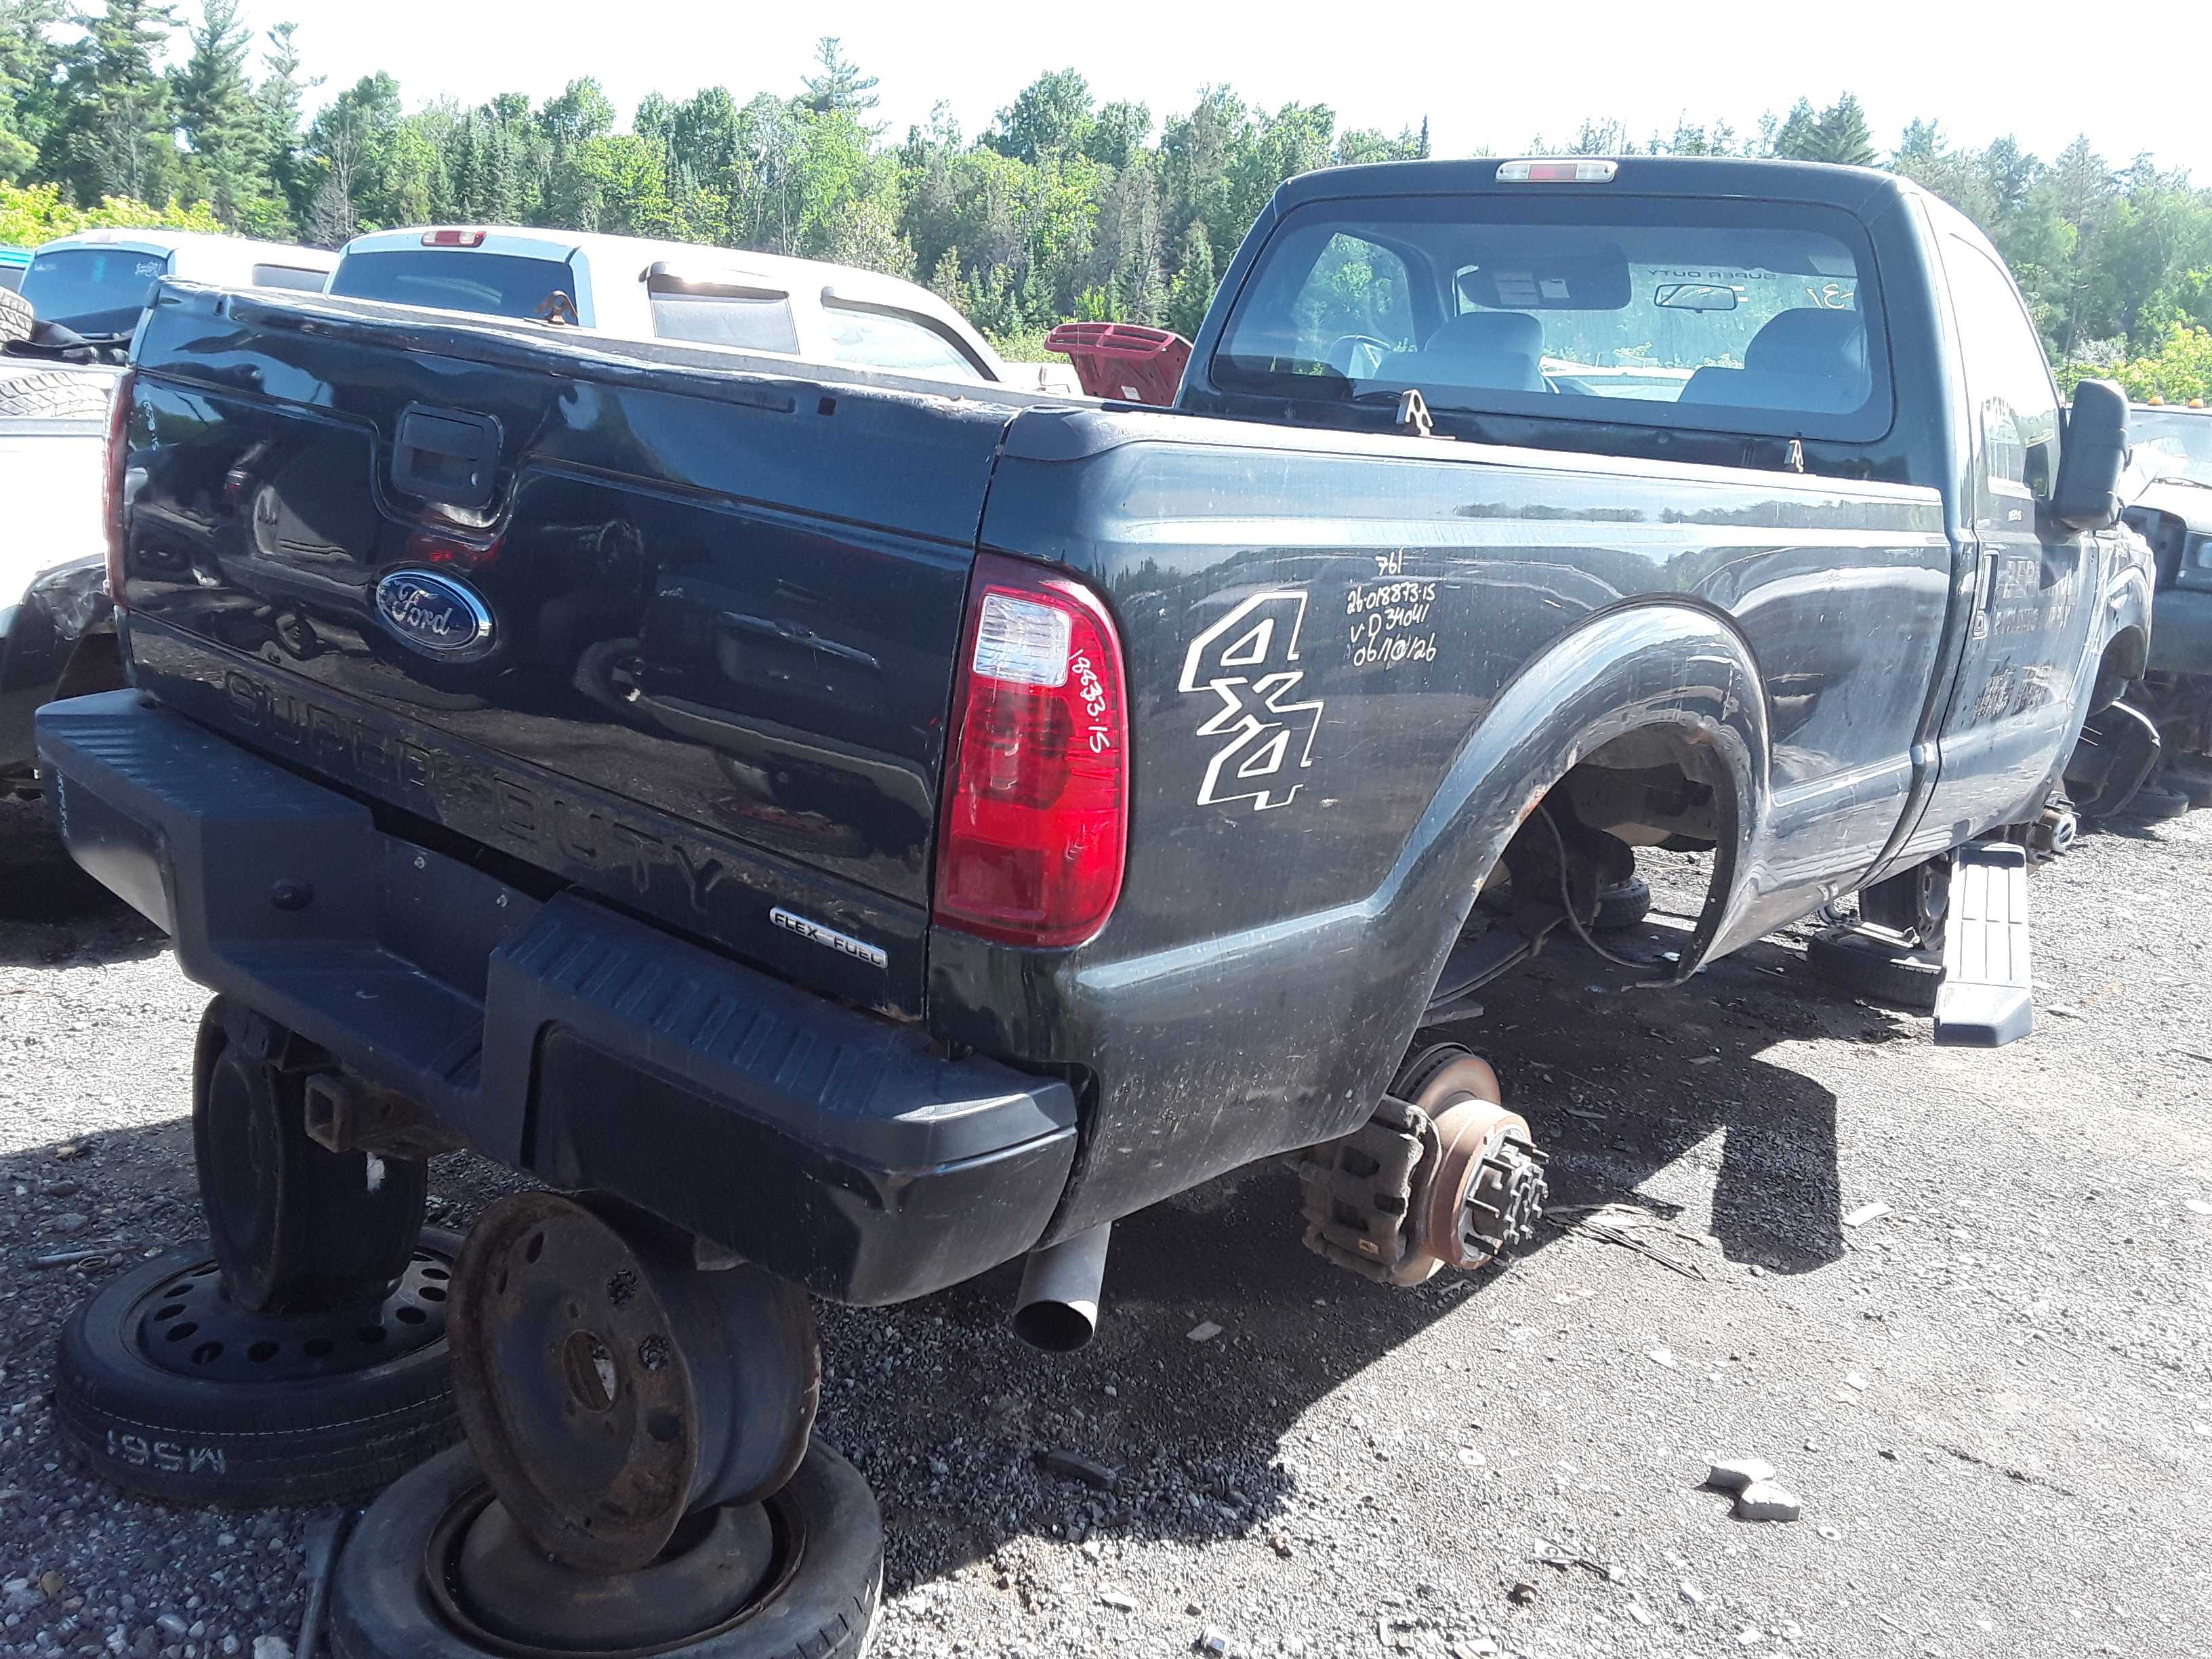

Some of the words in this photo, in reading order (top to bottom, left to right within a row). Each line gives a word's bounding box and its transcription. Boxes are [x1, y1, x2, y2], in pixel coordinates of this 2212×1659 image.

[1375, 548, 1402, 575] 761
[391, 581, 453, 636] Ford
[224, 668, 432, 790] SUPER
[493, 774, 725, 914] DUTY
[775, 913, 819, 941] FLEX
[834, 937, 881, 964] FUEL
